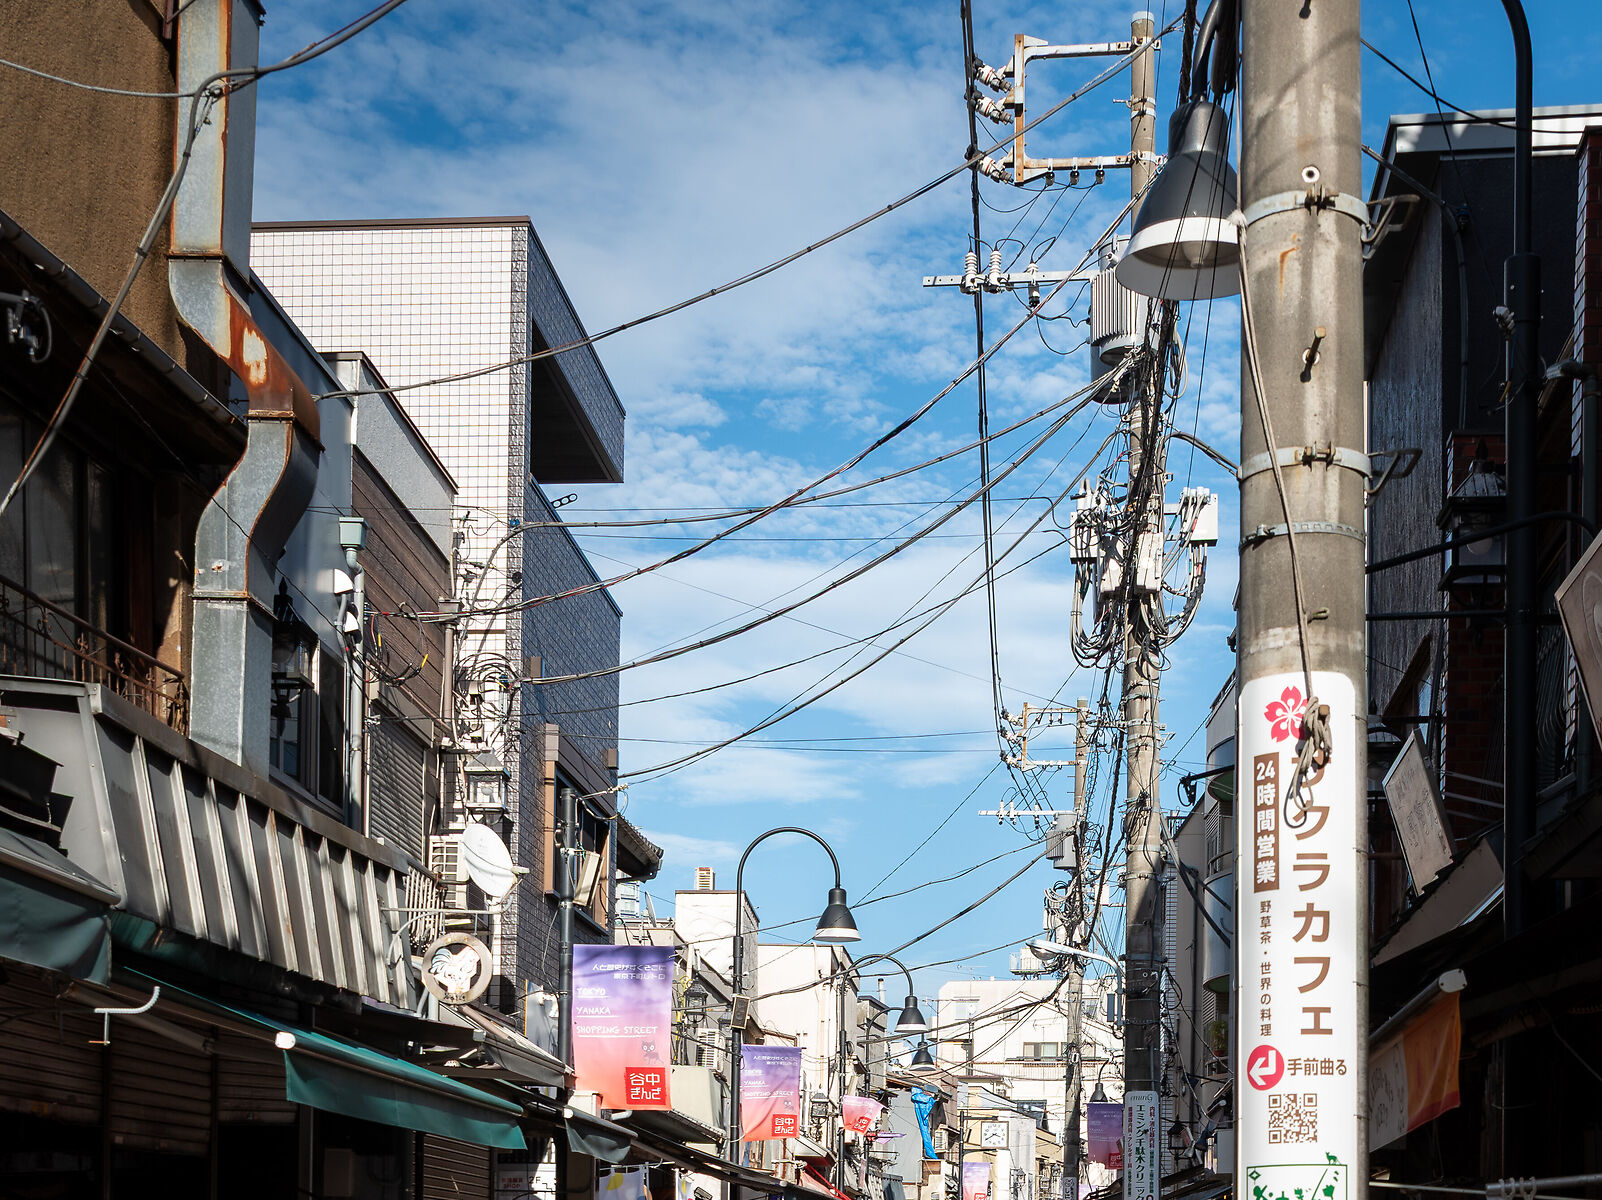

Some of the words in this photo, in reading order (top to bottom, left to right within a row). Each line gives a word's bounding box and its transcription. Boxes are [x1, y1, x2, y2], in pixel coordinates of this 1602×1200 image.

[1256, 760, 1276, 884] 24時間営業
[1260, 900, 1272, 1037] 野草茶・世界の料理
[576, 1006, 612, 1015] YANAKA
[576, 1025, 620, 1034] SHOPPING
[623, 1025, 659, 1034] STREET
[1287, 1058, 1347, 1076] 手前曲る
[629, 1072, 661, 1087] 谷中
[630, 1086, 662, 1101] ぎんざ
